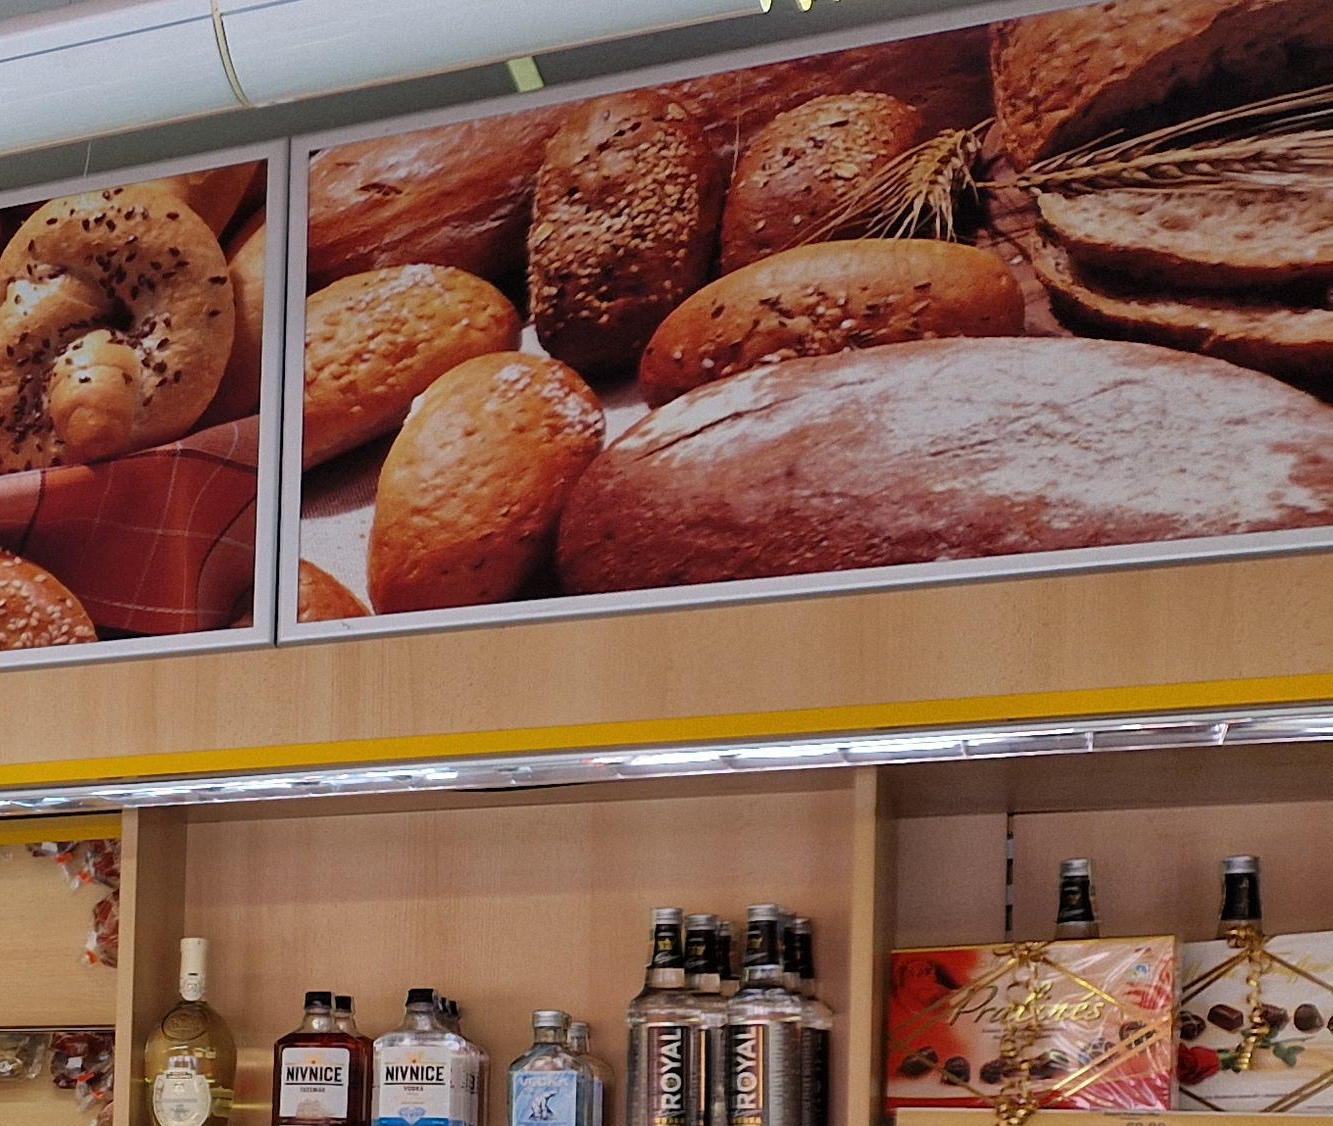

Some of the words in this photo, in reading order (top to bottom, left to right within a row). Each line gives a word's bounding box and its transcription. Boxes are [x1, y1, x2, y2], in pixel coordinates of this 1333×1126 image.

[286, 1066, 343, 1082] NIVNICE
[385, 1066, 445, 1082] NIVNICE
[660, 1028, 682, 1110] ROYAL
[736, 1026, 757, 1110] ROYAL
